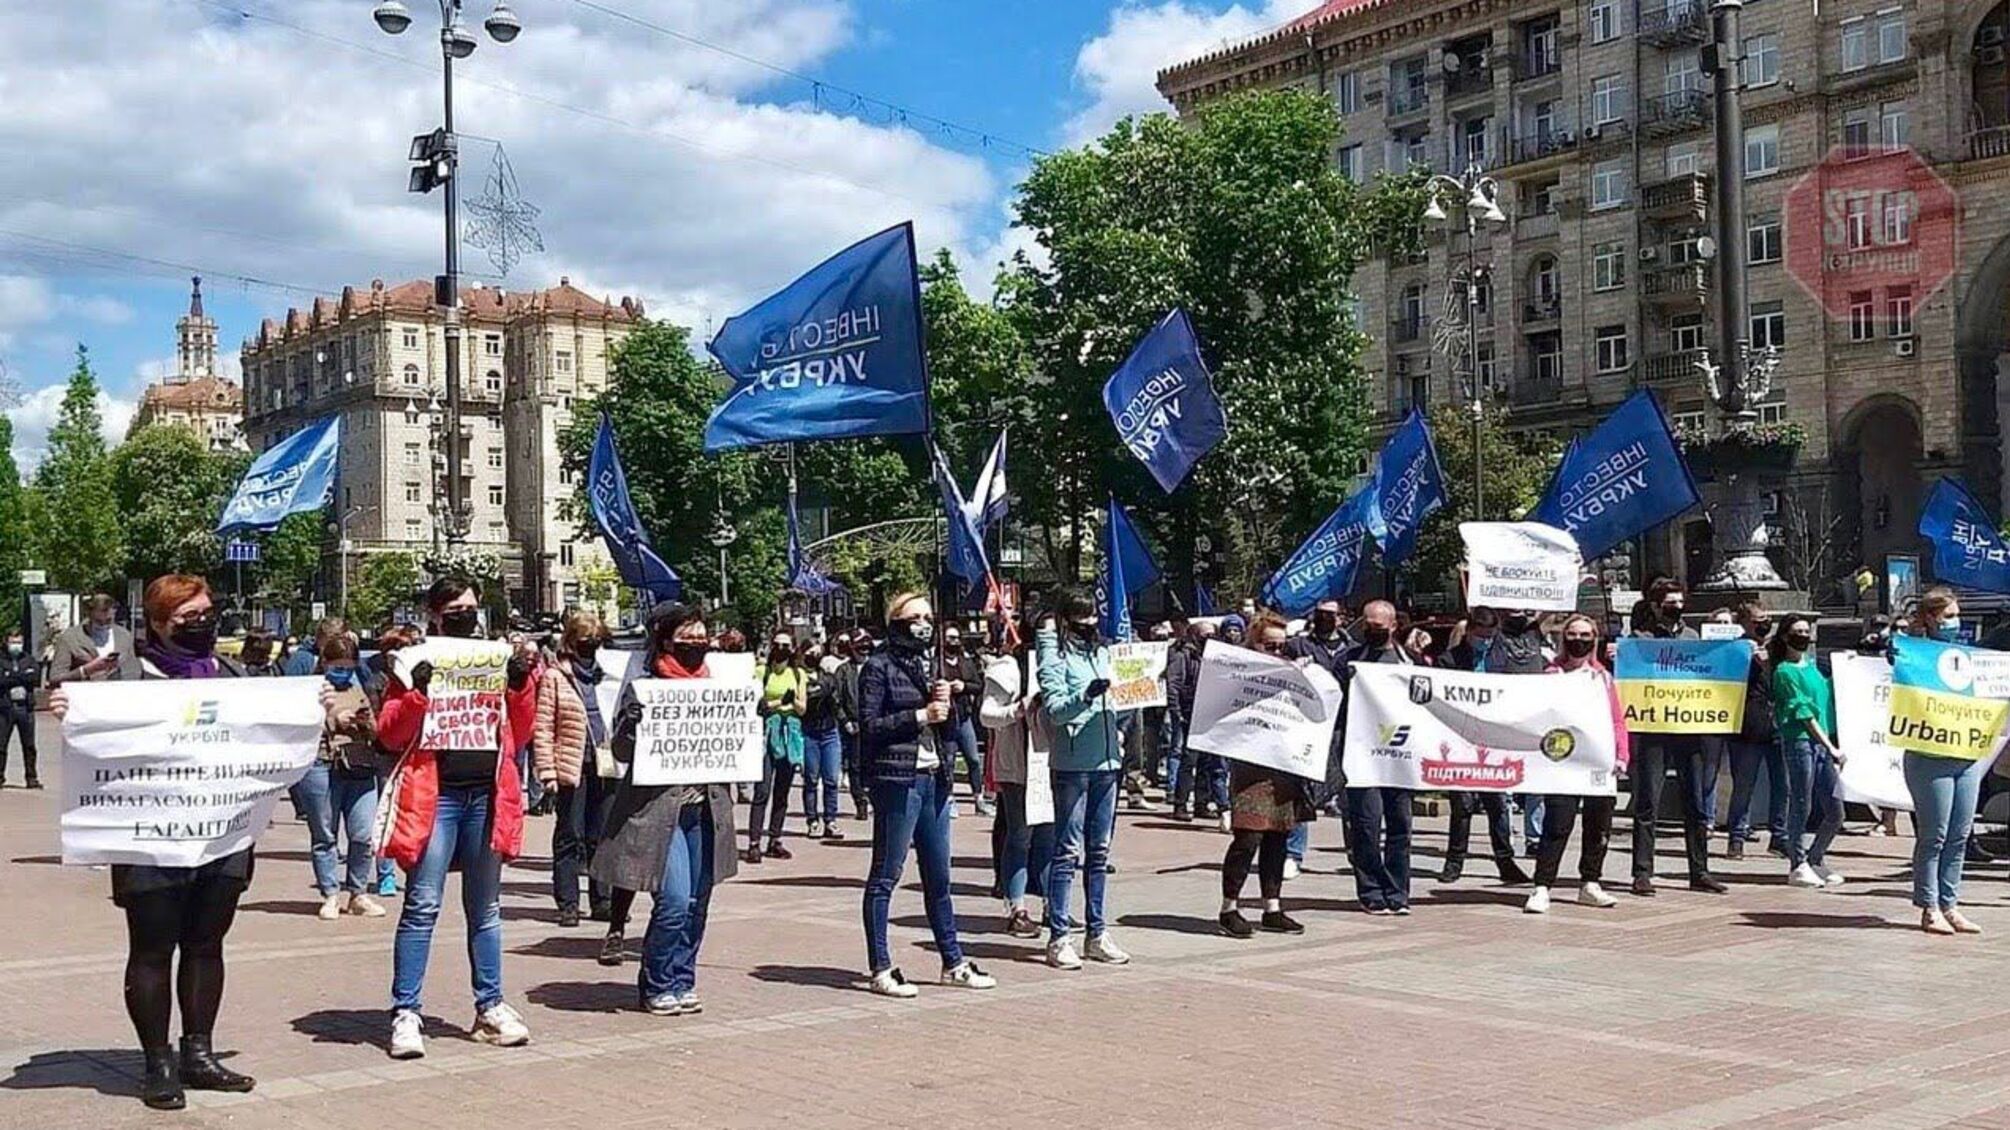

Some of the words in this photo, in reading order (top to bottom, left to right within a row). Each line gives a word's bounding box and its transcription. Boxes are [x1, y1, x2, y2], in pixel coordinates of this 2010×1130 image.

[1485, 566, 1500, 580] НЕ
[1674, 652, 1698, 662] Art
[1673, 664, 1713, 674] House
[647, 689, 697, 704] 13000
[701, 686, 756, 703] СІМЕЙ
[1643, 685, 1712, 702] Почуйте
[650, 706, 681, 720] БЕЗ
[686, 705, 747, 720] ЖИТЛА
[1624, 704, 1656, 723] Art
[1664, 705, 1729, 724] House
[1925, 697, 1993, 721] Почуйте
[641, 722, 660, 738] НЕ
[666, 720, 758, 737] БЛОКУЙТЕ
[1889, 714, 1961, 746] Urban
[650, 737, 745, 757] ДОБУДОВУ
[1427, 766, 1517, 782] ПІДТРИМАЙ
[79, 793, 207, 808] ВИМАГАЄМО
